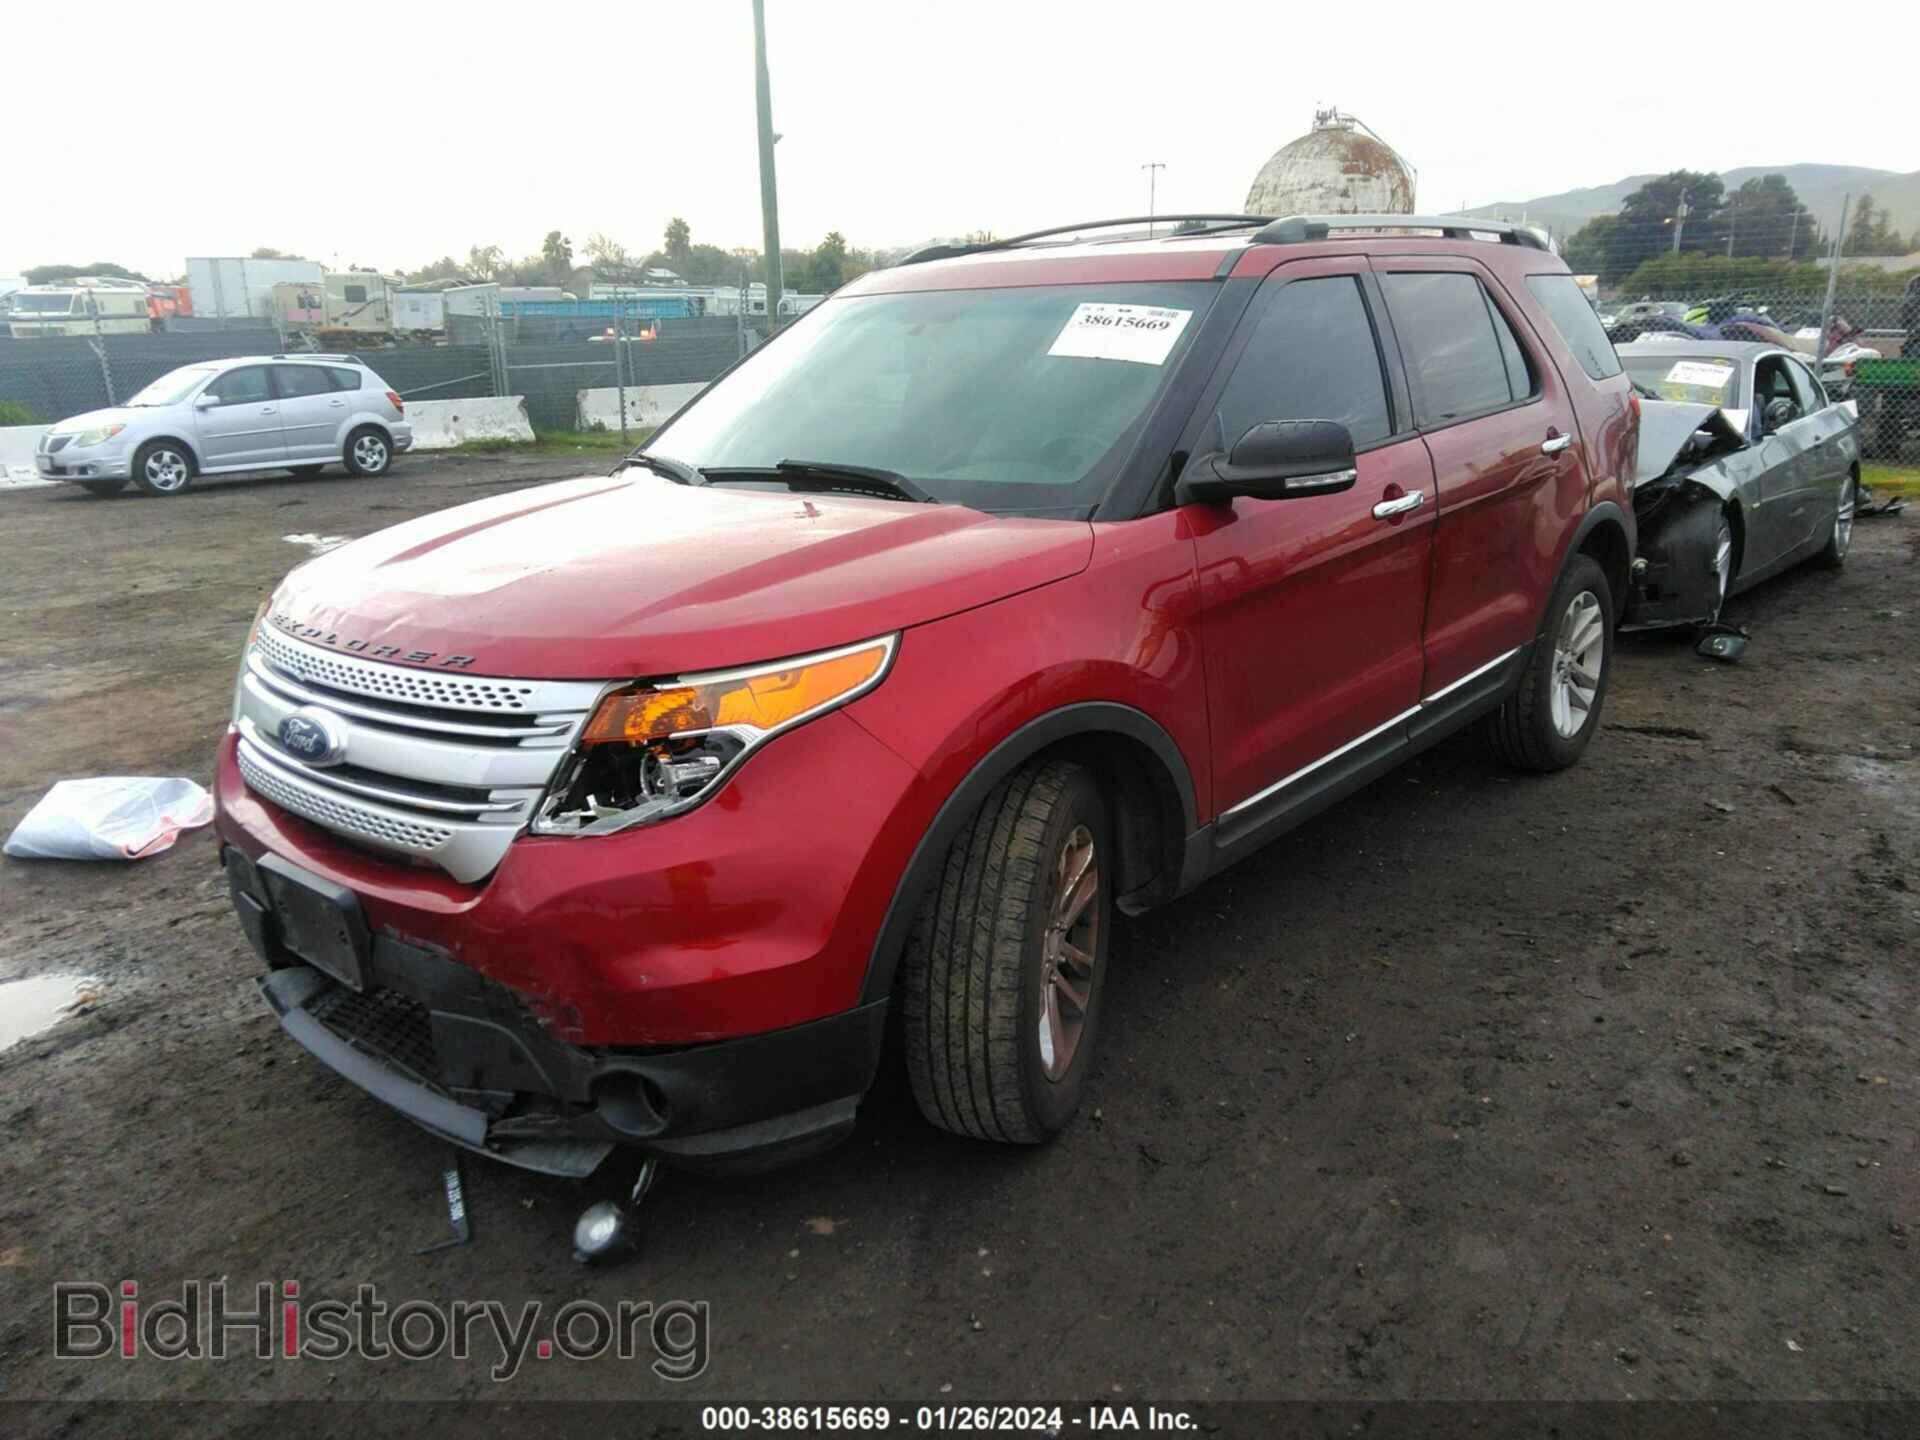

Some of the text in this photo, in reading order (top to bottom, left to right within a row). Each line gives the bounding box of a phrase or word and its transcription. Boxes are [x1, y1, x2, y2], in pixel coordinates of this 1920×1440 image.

[1078, 314, 1171, 330] 38615669
[273, 613, 476, 668] EXPLORER
[284, 718, 319, 752] Ford
